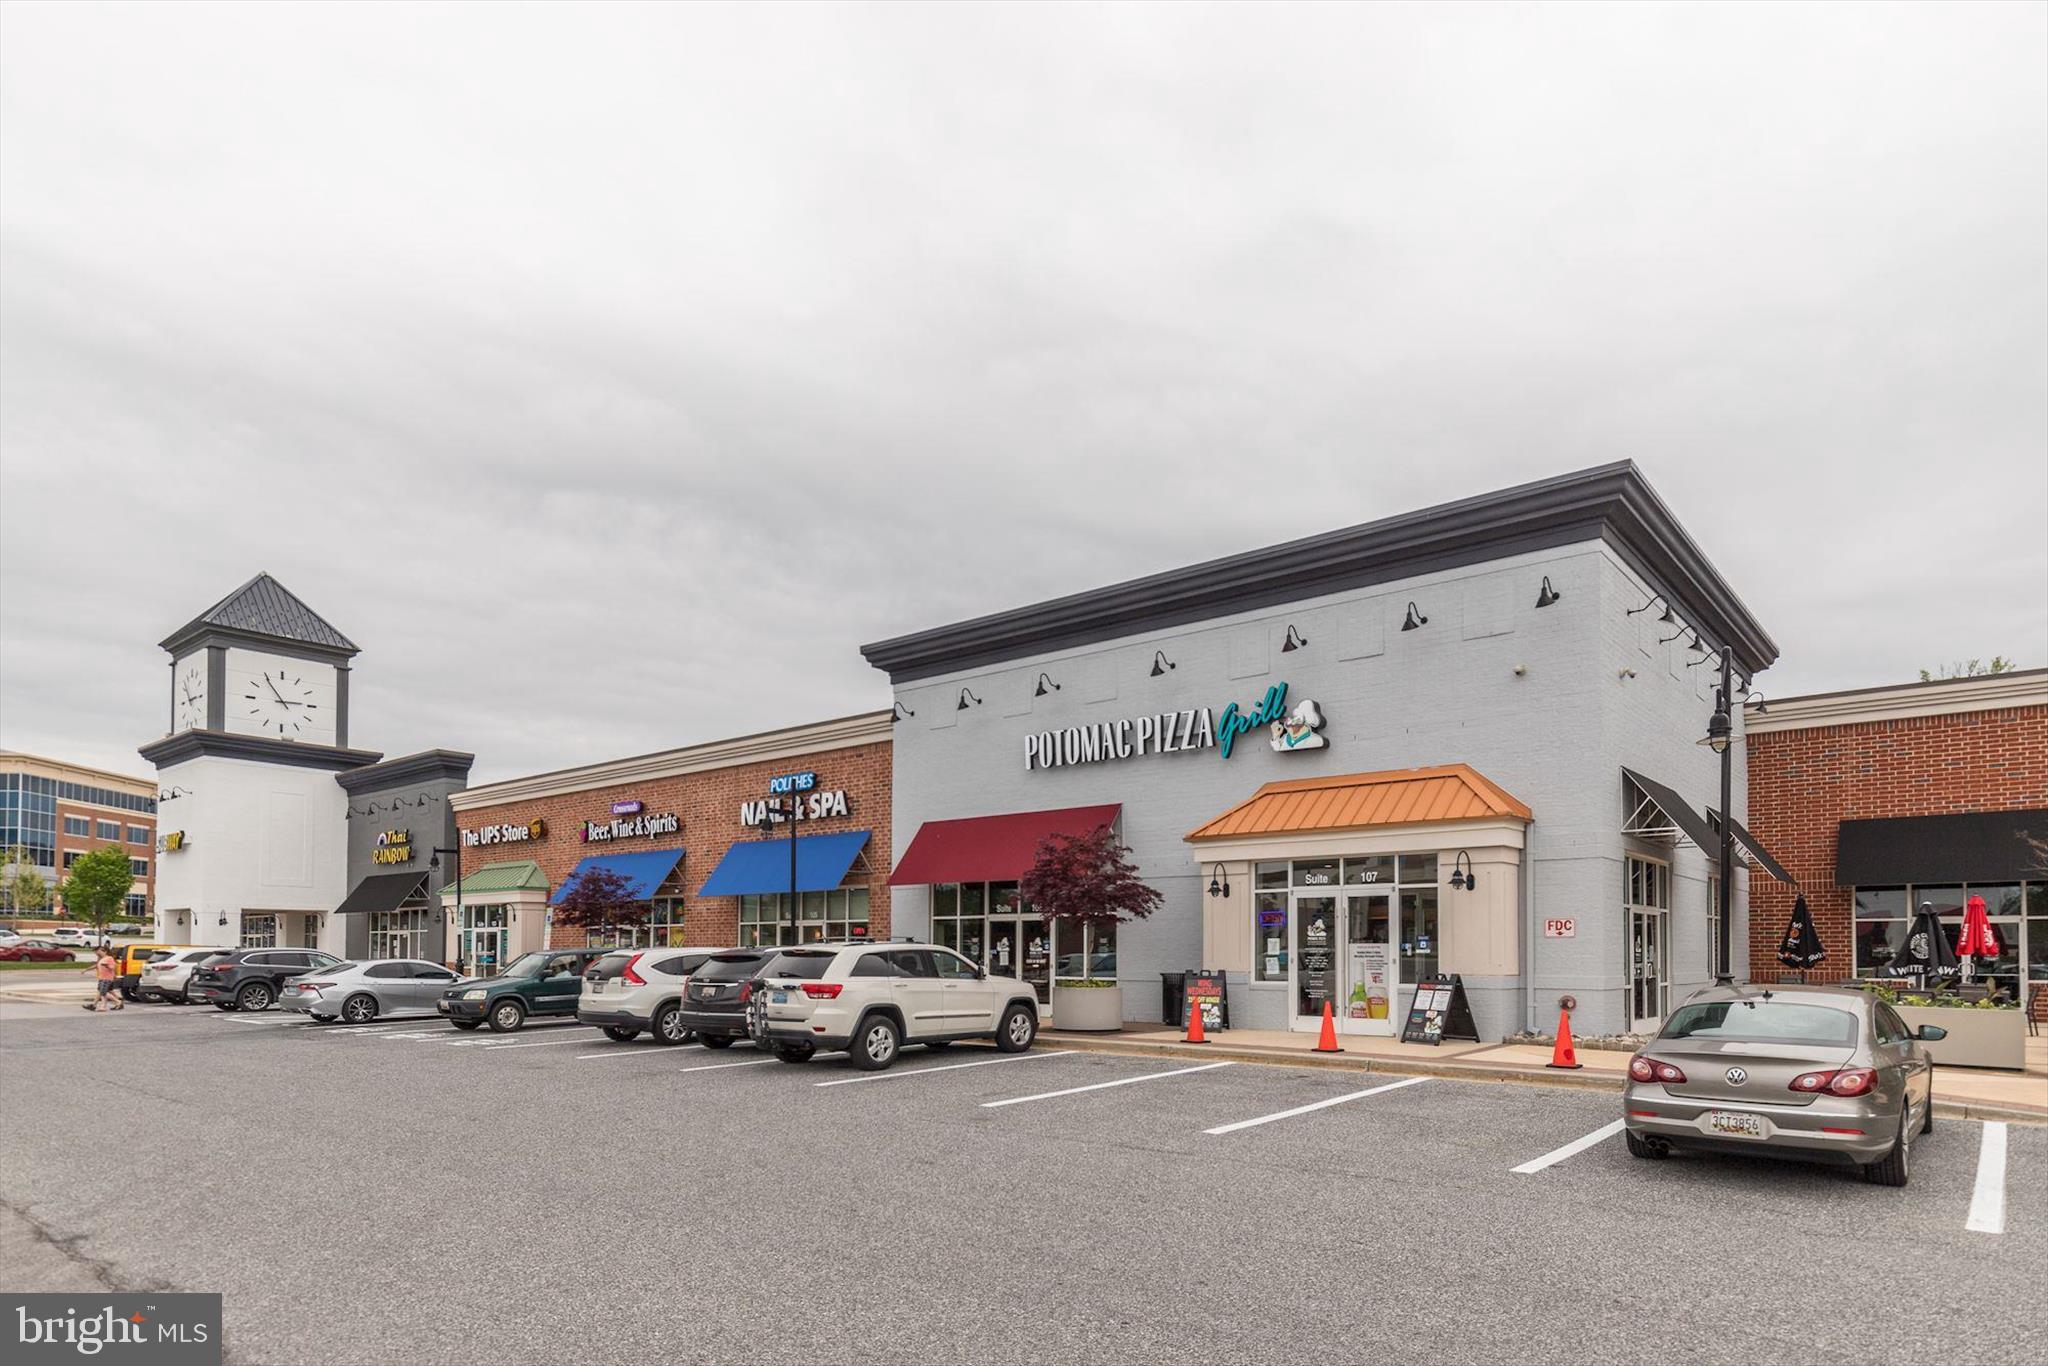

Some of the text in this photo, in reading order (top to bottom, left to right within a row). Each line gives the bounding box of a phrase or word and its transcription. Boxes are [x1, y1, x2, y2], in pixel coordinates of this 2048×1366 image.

[1024, 681, 1289, 770] POTOMAC PIZZA Grill
[809, 790, 848, 819] SPA
[386, 829, 407, 845] Thai
[462, 823, 529, 847] The UPS Store
[588, 812, 678, 841] Beer, Wine & Spirits
[372, 846, 411, 865] RAINBOW
[1305, 872, 1378, 885] Suite 107
[1547, 920, 1572, 931] FDC
